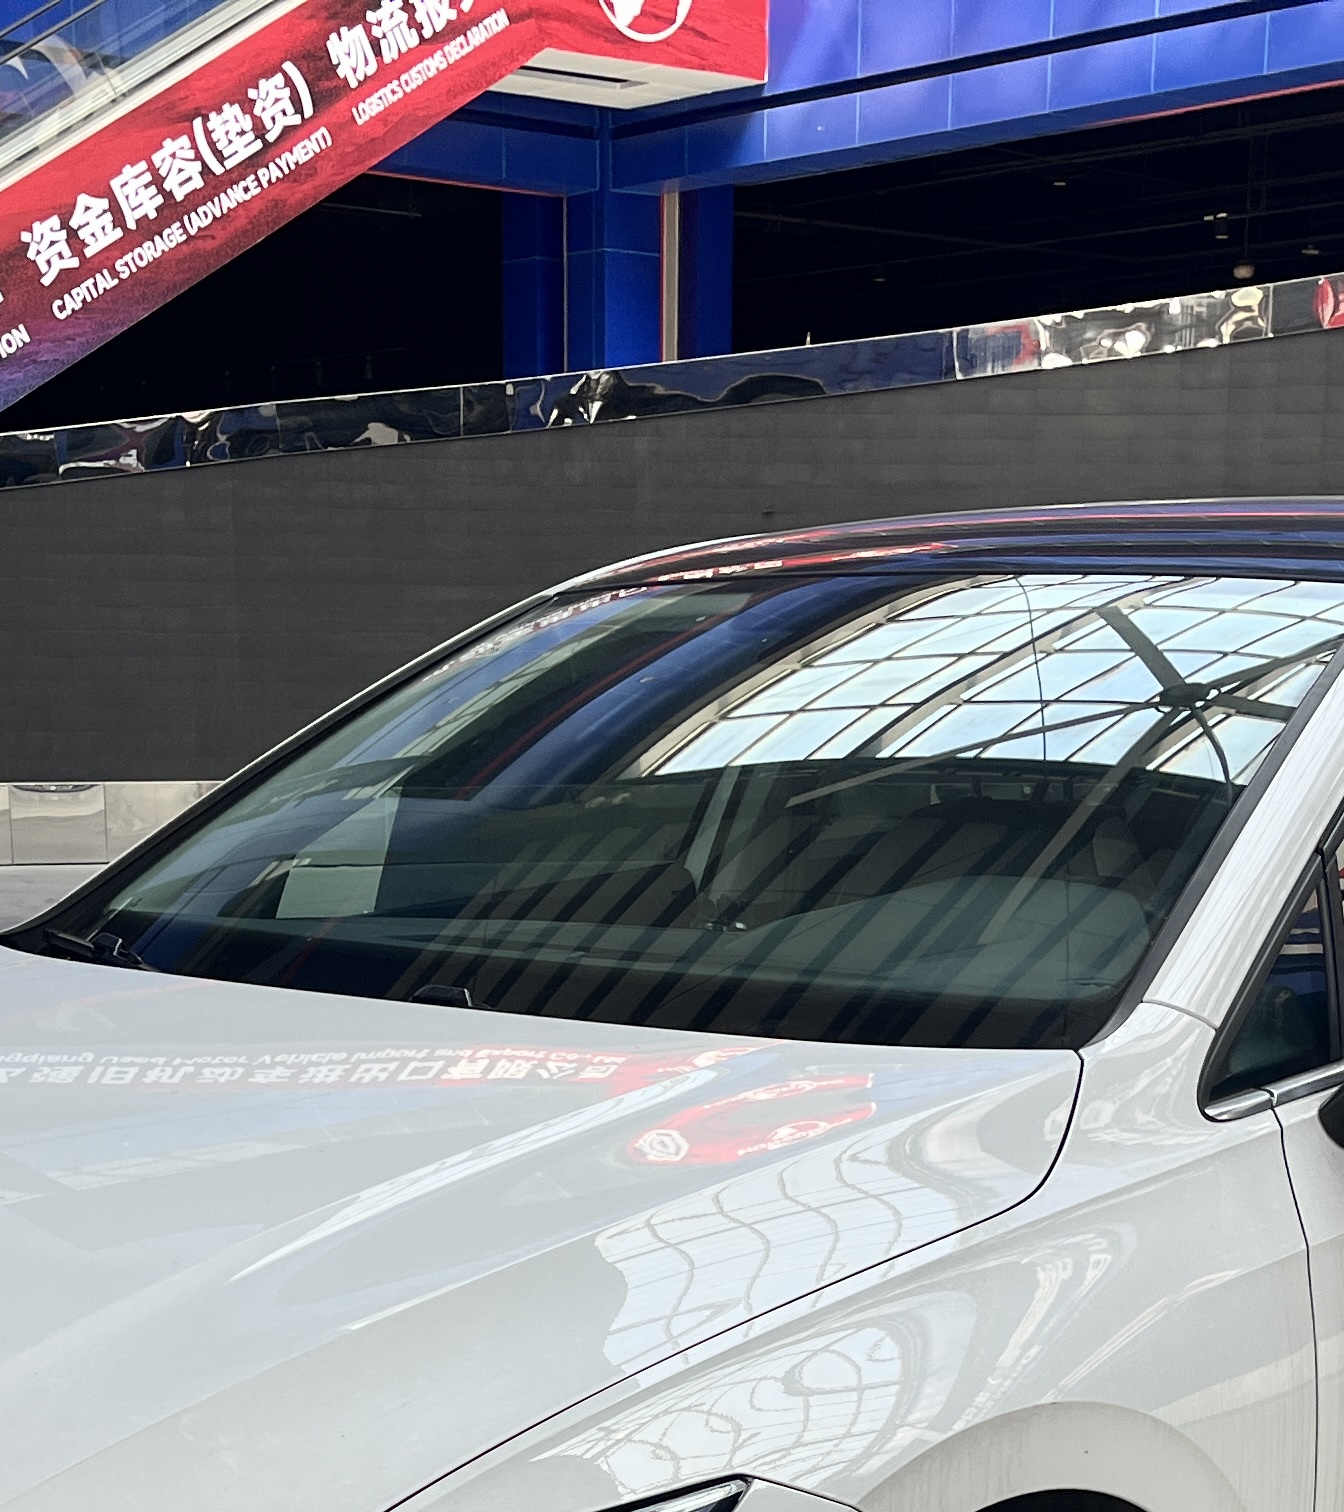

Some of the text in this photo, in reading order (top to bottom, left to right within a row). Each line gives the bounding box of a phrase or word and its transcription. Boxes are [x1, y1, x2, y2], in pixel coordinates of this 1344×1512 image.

[326, 0, 474, 89] 物流报
[351, 8, 510, 126] LOGISTICS CUSTOMS DECLARATION
[20, 61, 314, 287] 资金库容(垫资)
[51, 126, 333, 320] CAPITAL STORAGE (ADVANCE PAYMENT)
